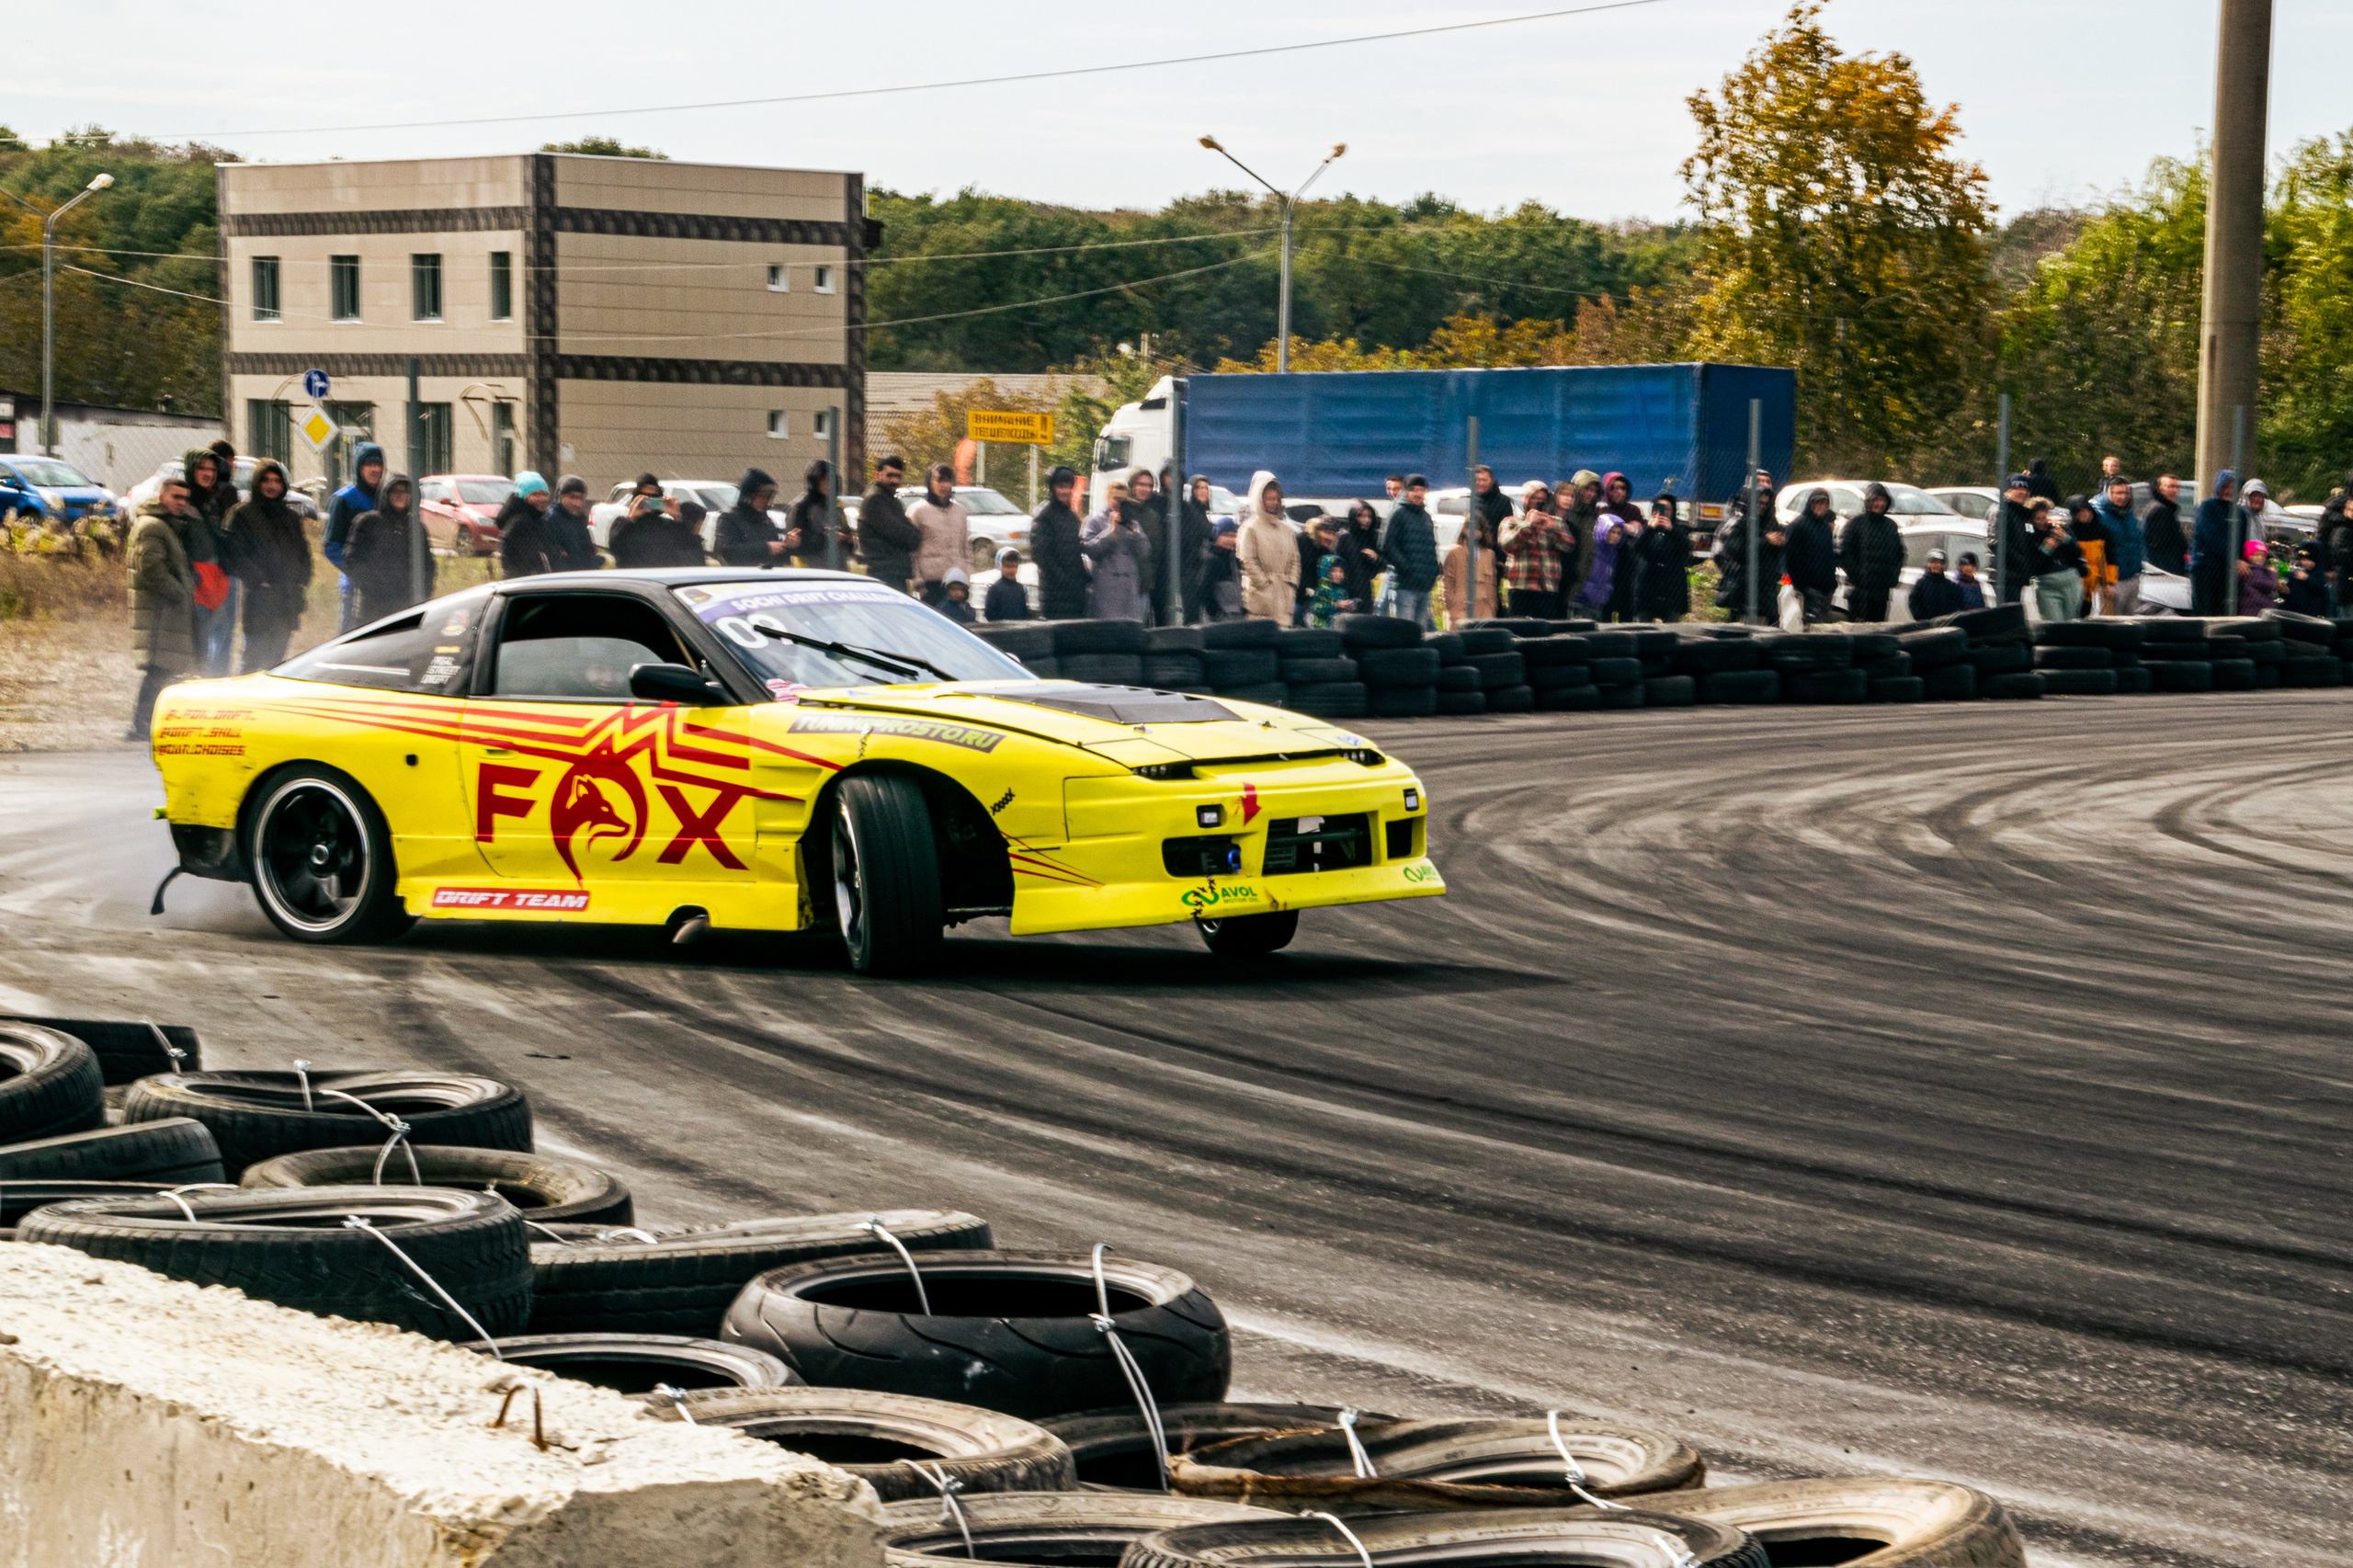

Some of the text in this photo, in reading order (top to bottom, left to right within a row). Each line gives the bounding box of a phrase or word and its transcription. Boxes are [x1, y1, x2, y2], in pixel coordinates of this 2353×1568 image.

[730, 594, 787, 611] SOCHI
[782, 592, 829, 606] DRIFT
[476, 754, 750, 878] FOX
[434, 891, 588, 908] DRIFT TEAM
[1222, 886, 1257, 898] AVOL
